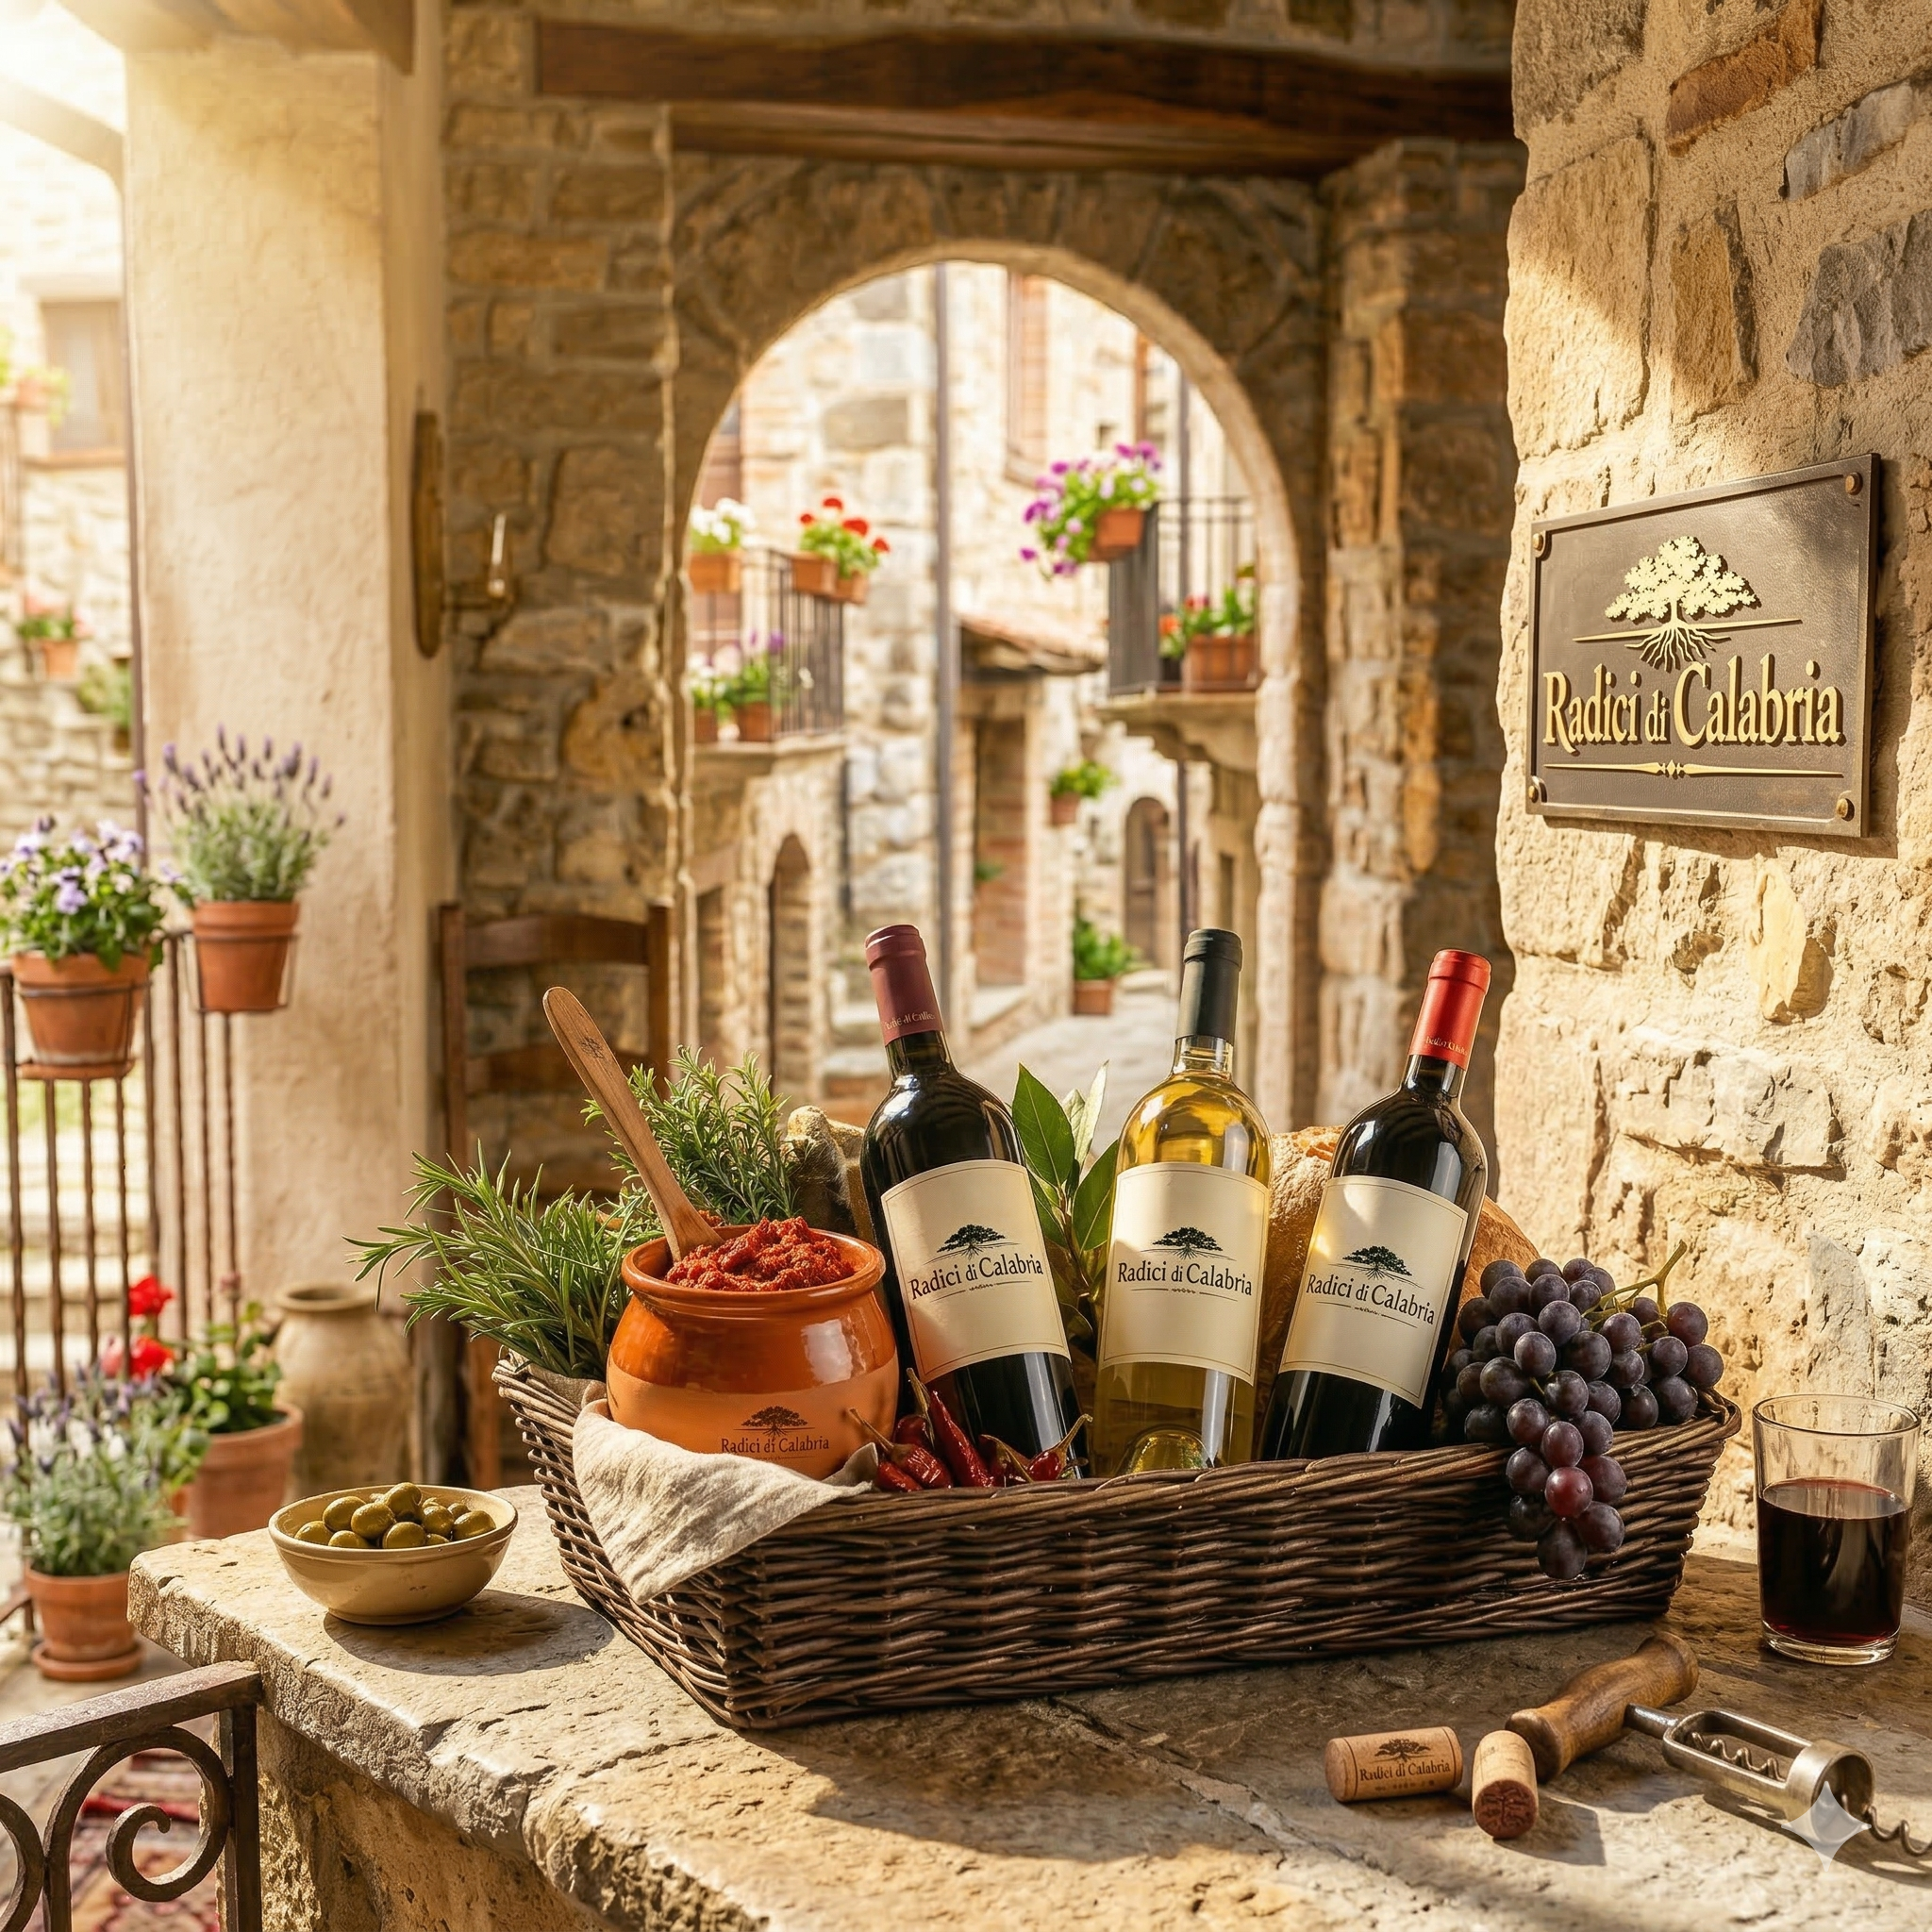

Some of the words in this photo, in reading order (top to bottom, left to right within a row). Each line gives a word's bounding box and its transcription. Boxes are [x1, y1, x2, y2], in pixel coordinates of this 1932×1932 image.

[1543, 664, 1641, 753] Radici
[1644, 689, 1671, 742] di
[1674, 653, 1842, 747] Calabria
[910, 1264, 962, 1300] Radici
[965, 1263, 977, 1282] di
[978, 1253, 1044, 1278] Calabria
[1117, 1260, 1167, 1283] Radici
[1171, 1265, 1183, 1283] di
[1186, 1262, 1253, 1296] Calabria
[1306, 1274, 1355, 1299] Radici
[1356, 1284, 1370, 1302] di
[1371, 1284, 1436, 1325] Calabria
[721, 1437, 761, 1454] Radici
[778, 1435, 830, 1453] Calabria
[1407, 1758, 1451, 1776] Calabria
